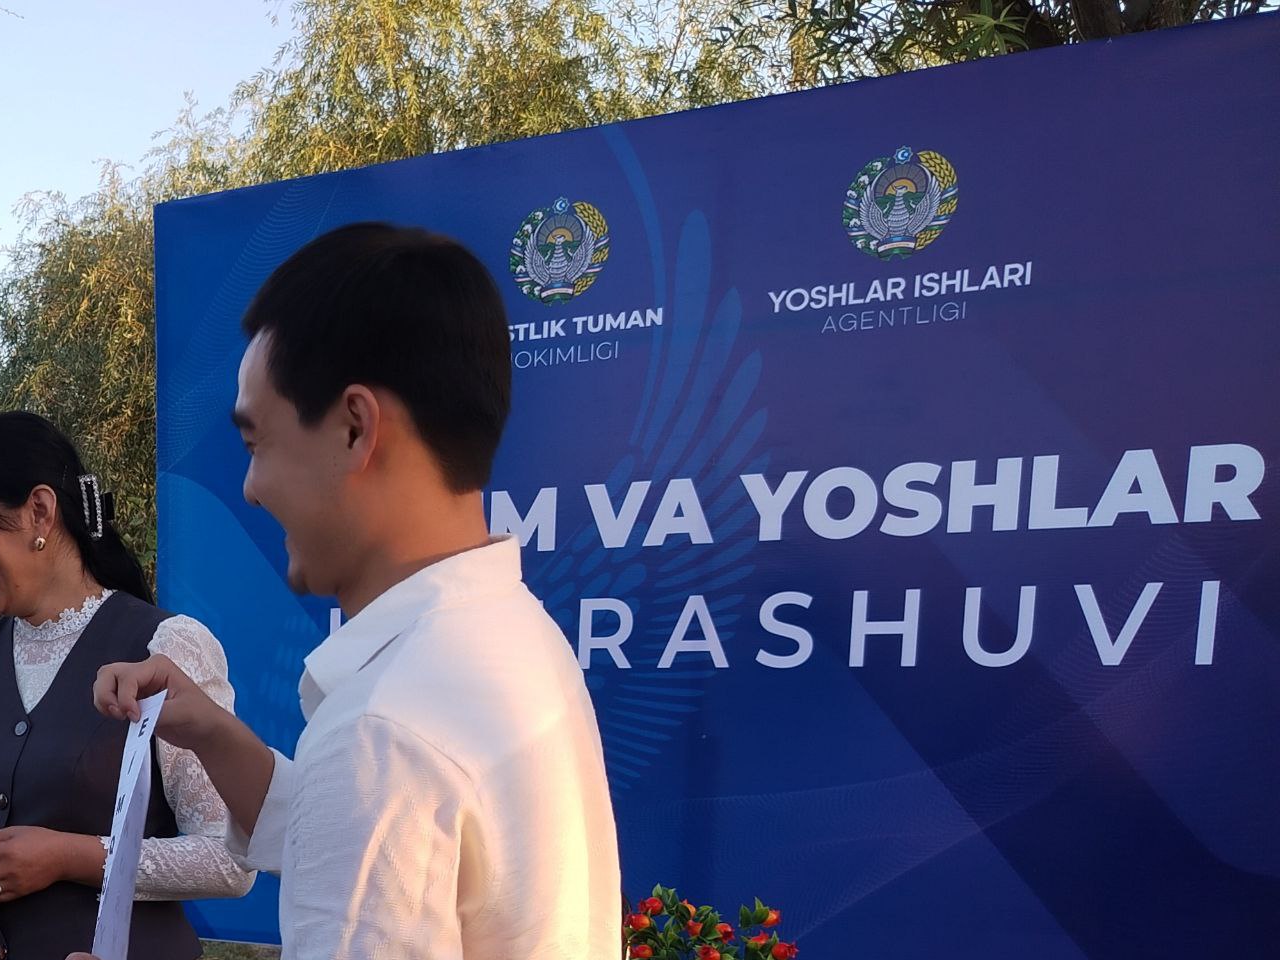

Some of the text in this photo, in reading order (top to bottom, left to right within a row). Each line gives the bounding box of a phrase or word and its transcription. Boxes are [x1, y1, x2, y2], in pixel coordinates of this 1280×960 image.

[768, 261, 1033, 313] YOSHLAR ISHLARI
[572, 307, 664, 335] TUMAN
[821, 301, 967, 334] AGENTLIGI
[510, 341, 619, 369] OKIMLIGI
[482, 443, 1267, 551] M VA YOSHLAR
[537, 579, 1221, 670] RASHUVI
